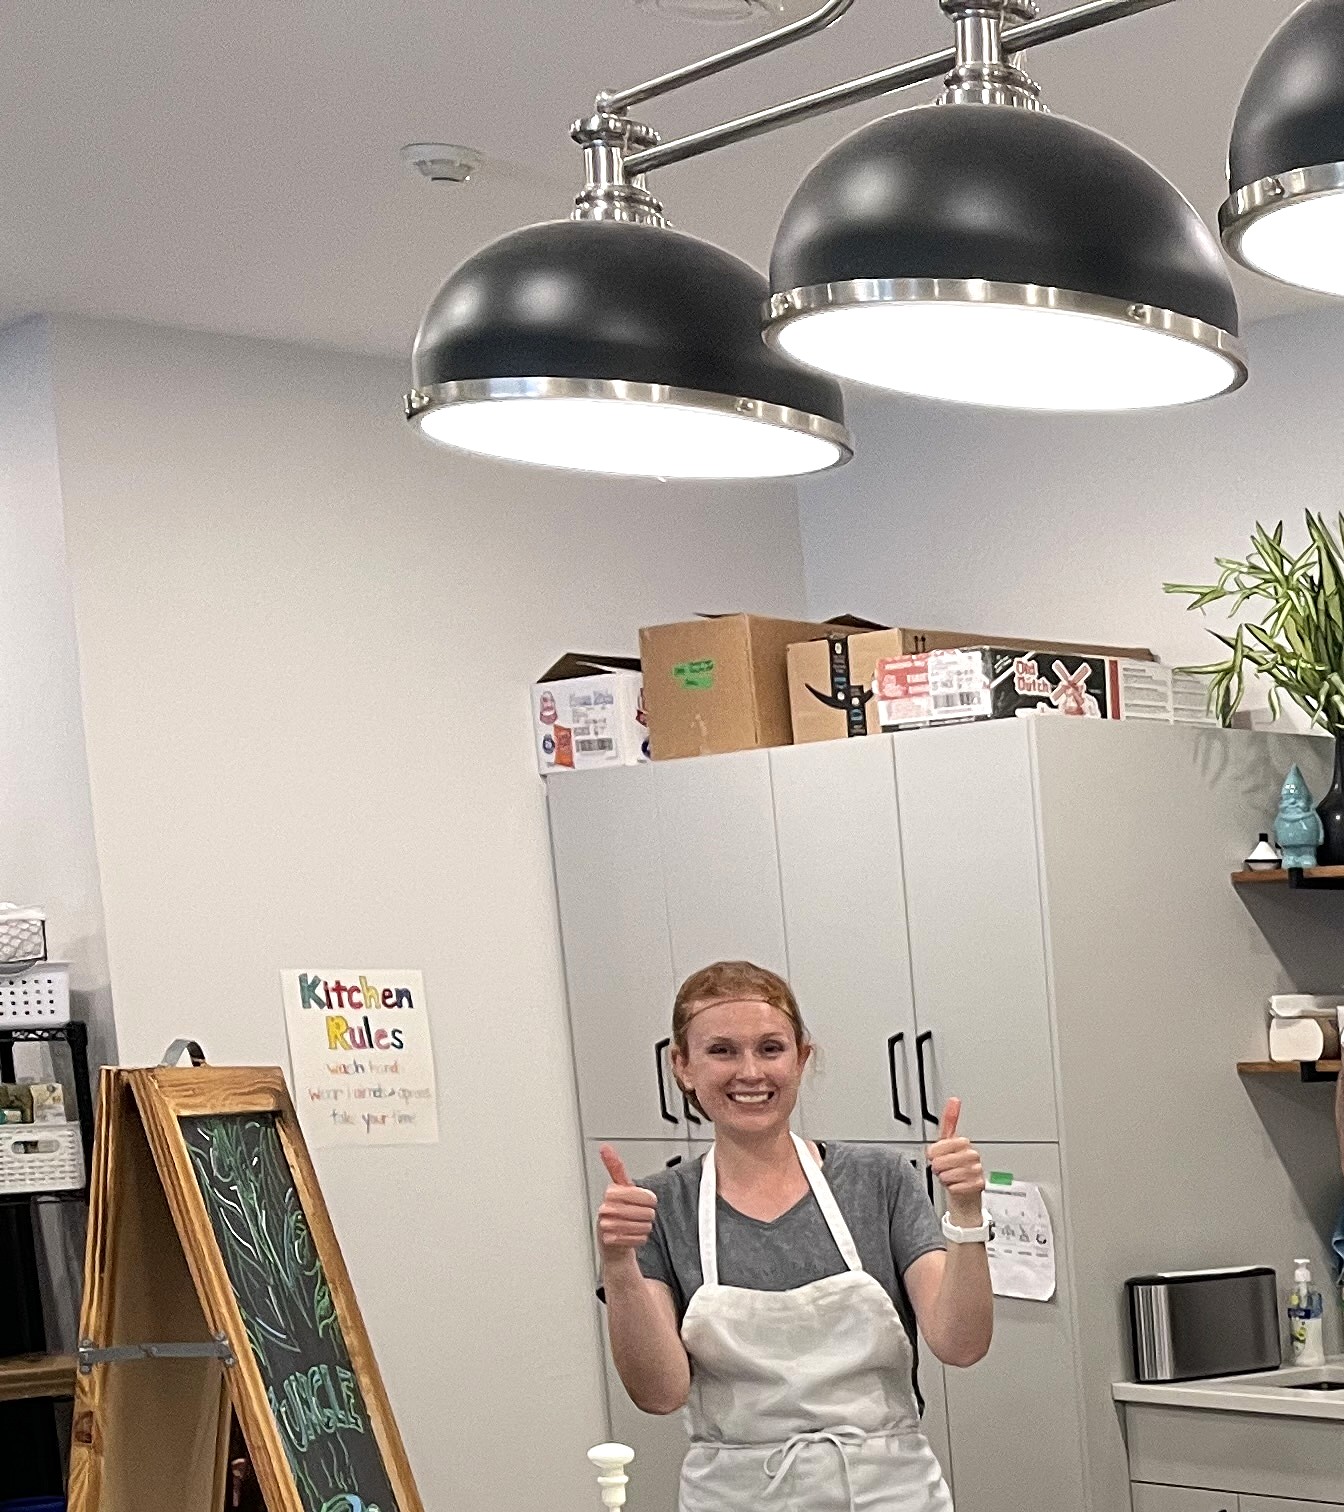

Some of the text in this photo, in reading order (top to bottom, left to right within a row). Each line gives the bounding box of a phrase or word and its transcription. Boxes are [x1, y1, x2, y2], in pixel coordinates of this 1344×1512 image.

[1015, 660, 1037, 677] Old
[1017, 678, 1051, 693] Dutch
[298, 973, 414, 1010] Kitchen
[325, 1015, 404, 1050] Rules
